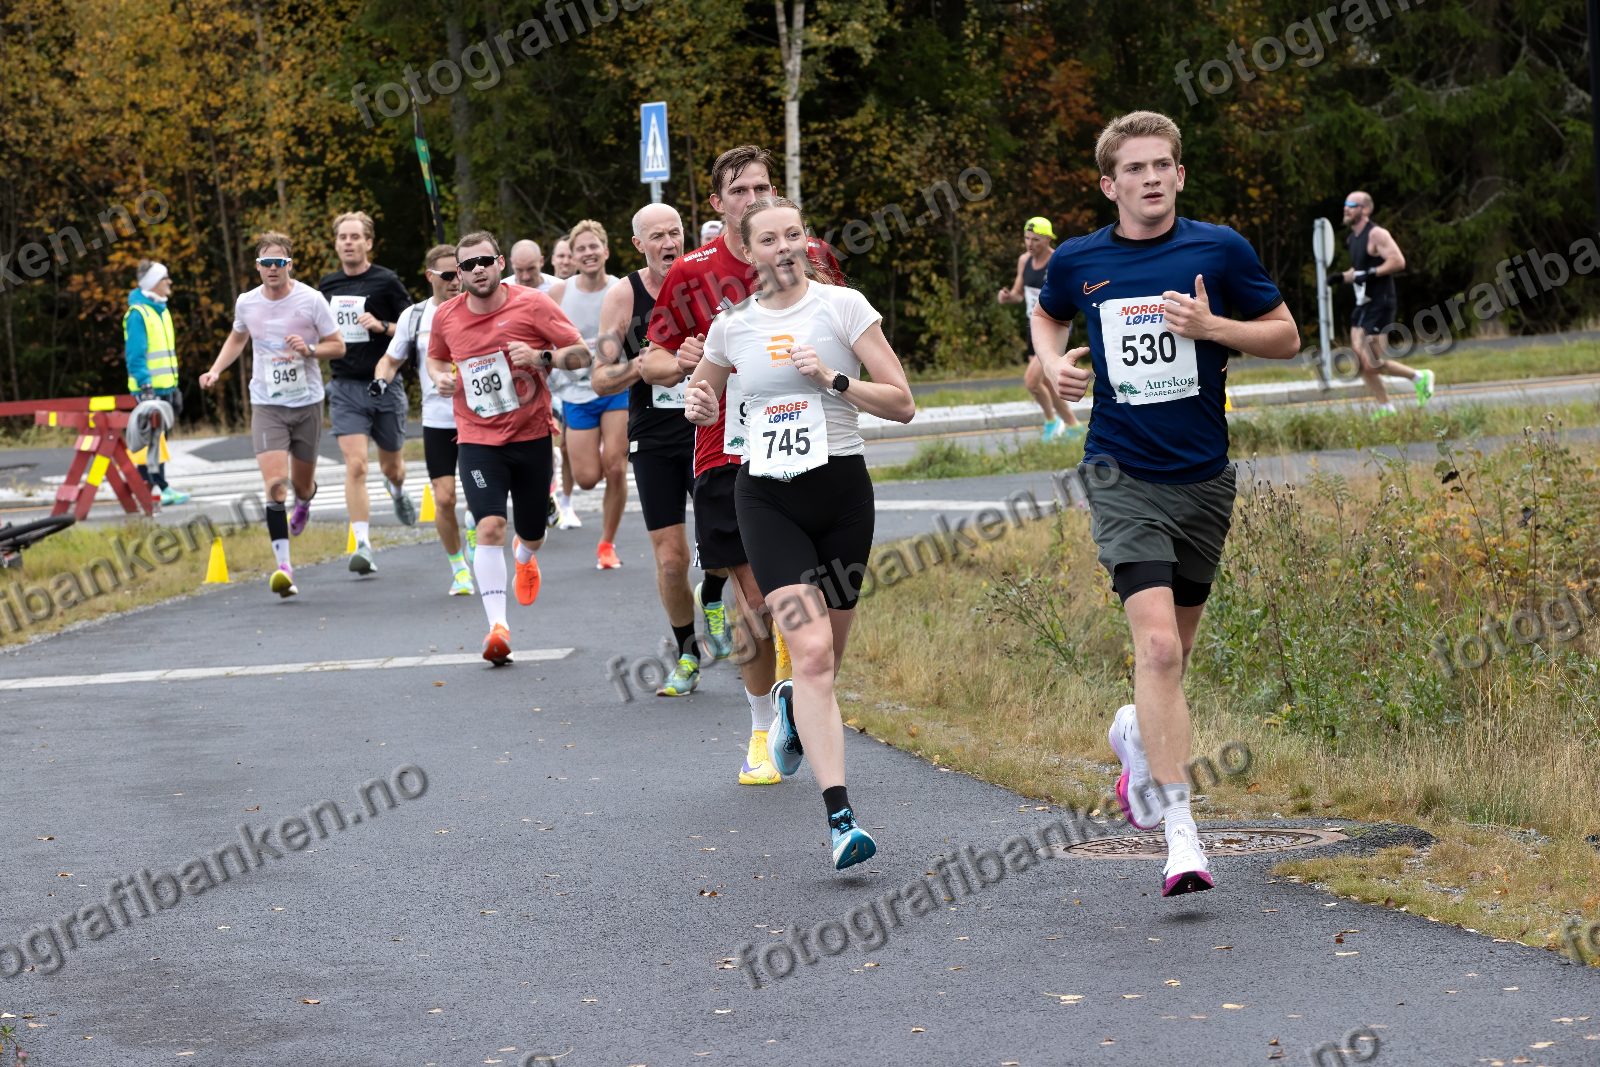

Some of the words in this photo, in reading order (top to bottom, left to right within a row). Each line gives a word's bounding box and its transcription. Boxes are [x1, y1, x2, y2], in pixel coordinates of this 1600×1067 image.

[1120, 303, 1165, 316] NORGE
[337, 311, 359, 325] 818
[1121, 331, 1177, 367] 530
[273, 368, 298, 385] 949
[1144, 376, 1195, 391] Aurskog
[471, 373, 502, 397] 389
[763, 400, 809, 416] NORGES
[768, 410, 802, 424] LØPET
[762, 427, 811, 460] 745
